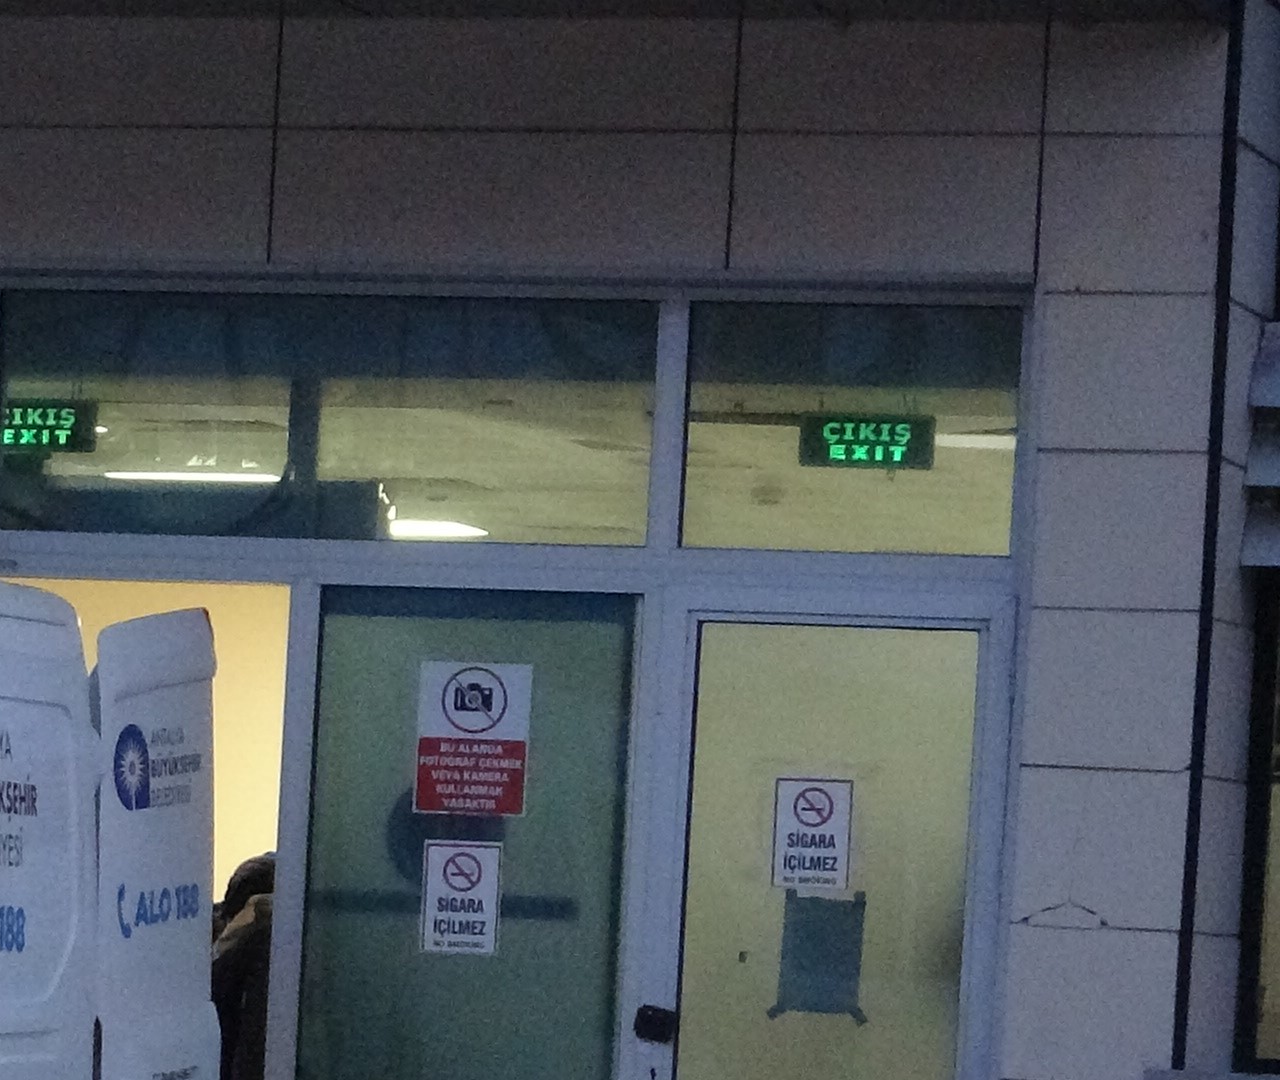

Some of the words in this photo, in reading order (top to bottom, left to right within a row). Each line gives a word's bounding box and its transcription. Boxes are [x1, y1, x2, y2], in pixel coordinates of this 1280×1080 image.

[3, 428, 72, 445] EXIT
[823, 422, 911, 445] ÇIKIŞ
[829, 444, 908, 461] EXIT
[786, 829, 836, 849] SİGARA
[783, 851, 838, 873] İÇİLMEZ
[134, 887, 172, 927] ALO
[437, 895, 485, 913] SİGARA
[433, 916, 487, 937] İÇİLMEZ
